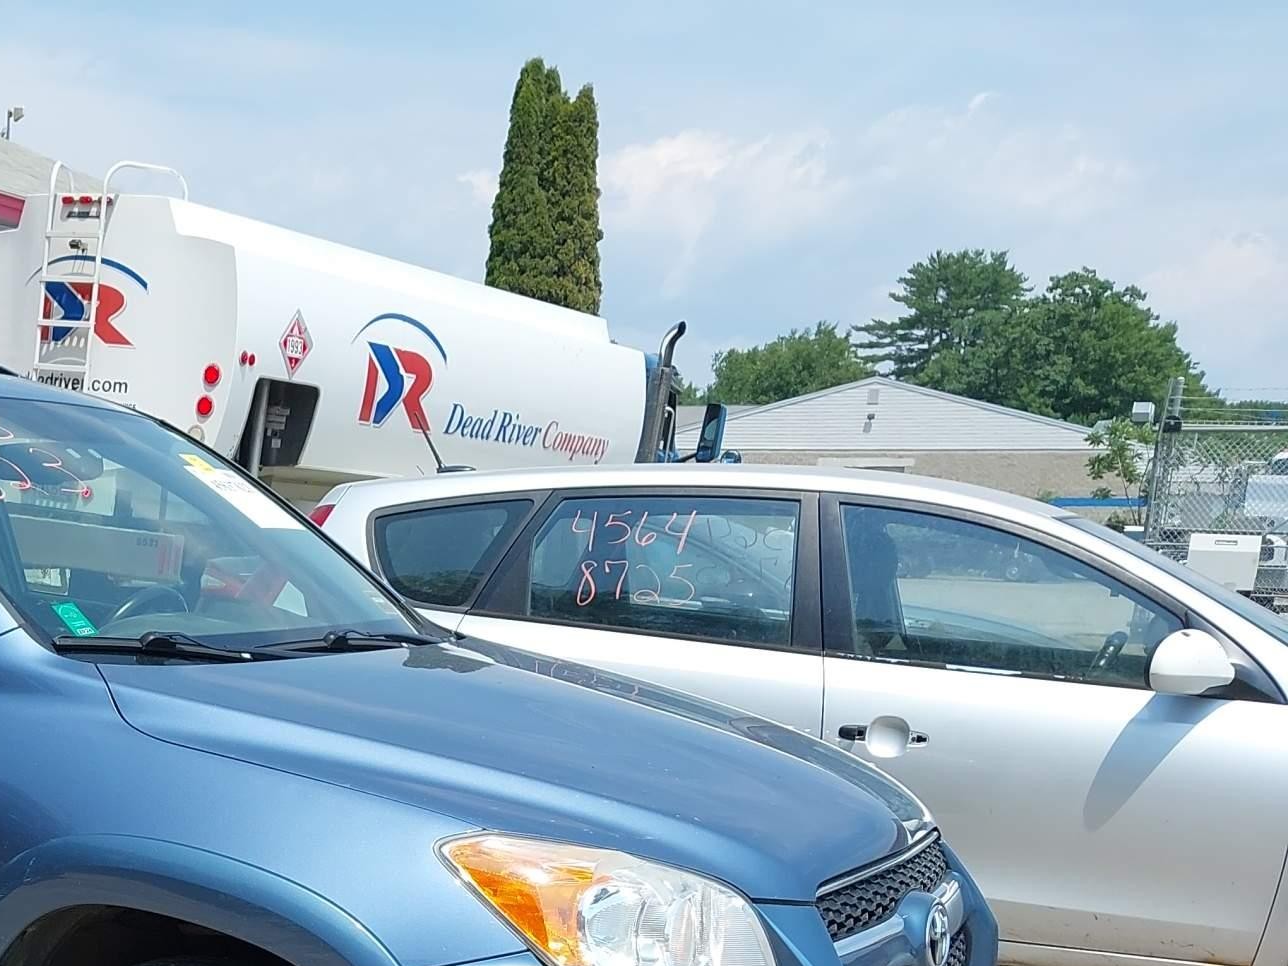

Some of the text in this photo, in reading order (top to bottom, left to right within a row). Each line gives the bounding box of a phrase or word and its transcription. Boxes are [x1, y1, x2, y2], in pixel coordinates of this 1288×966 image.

[443, 403, 610, 465] Dead River Company
[571, 509, 698, 555] 4564
[576, 560, 696, 607] 8725
